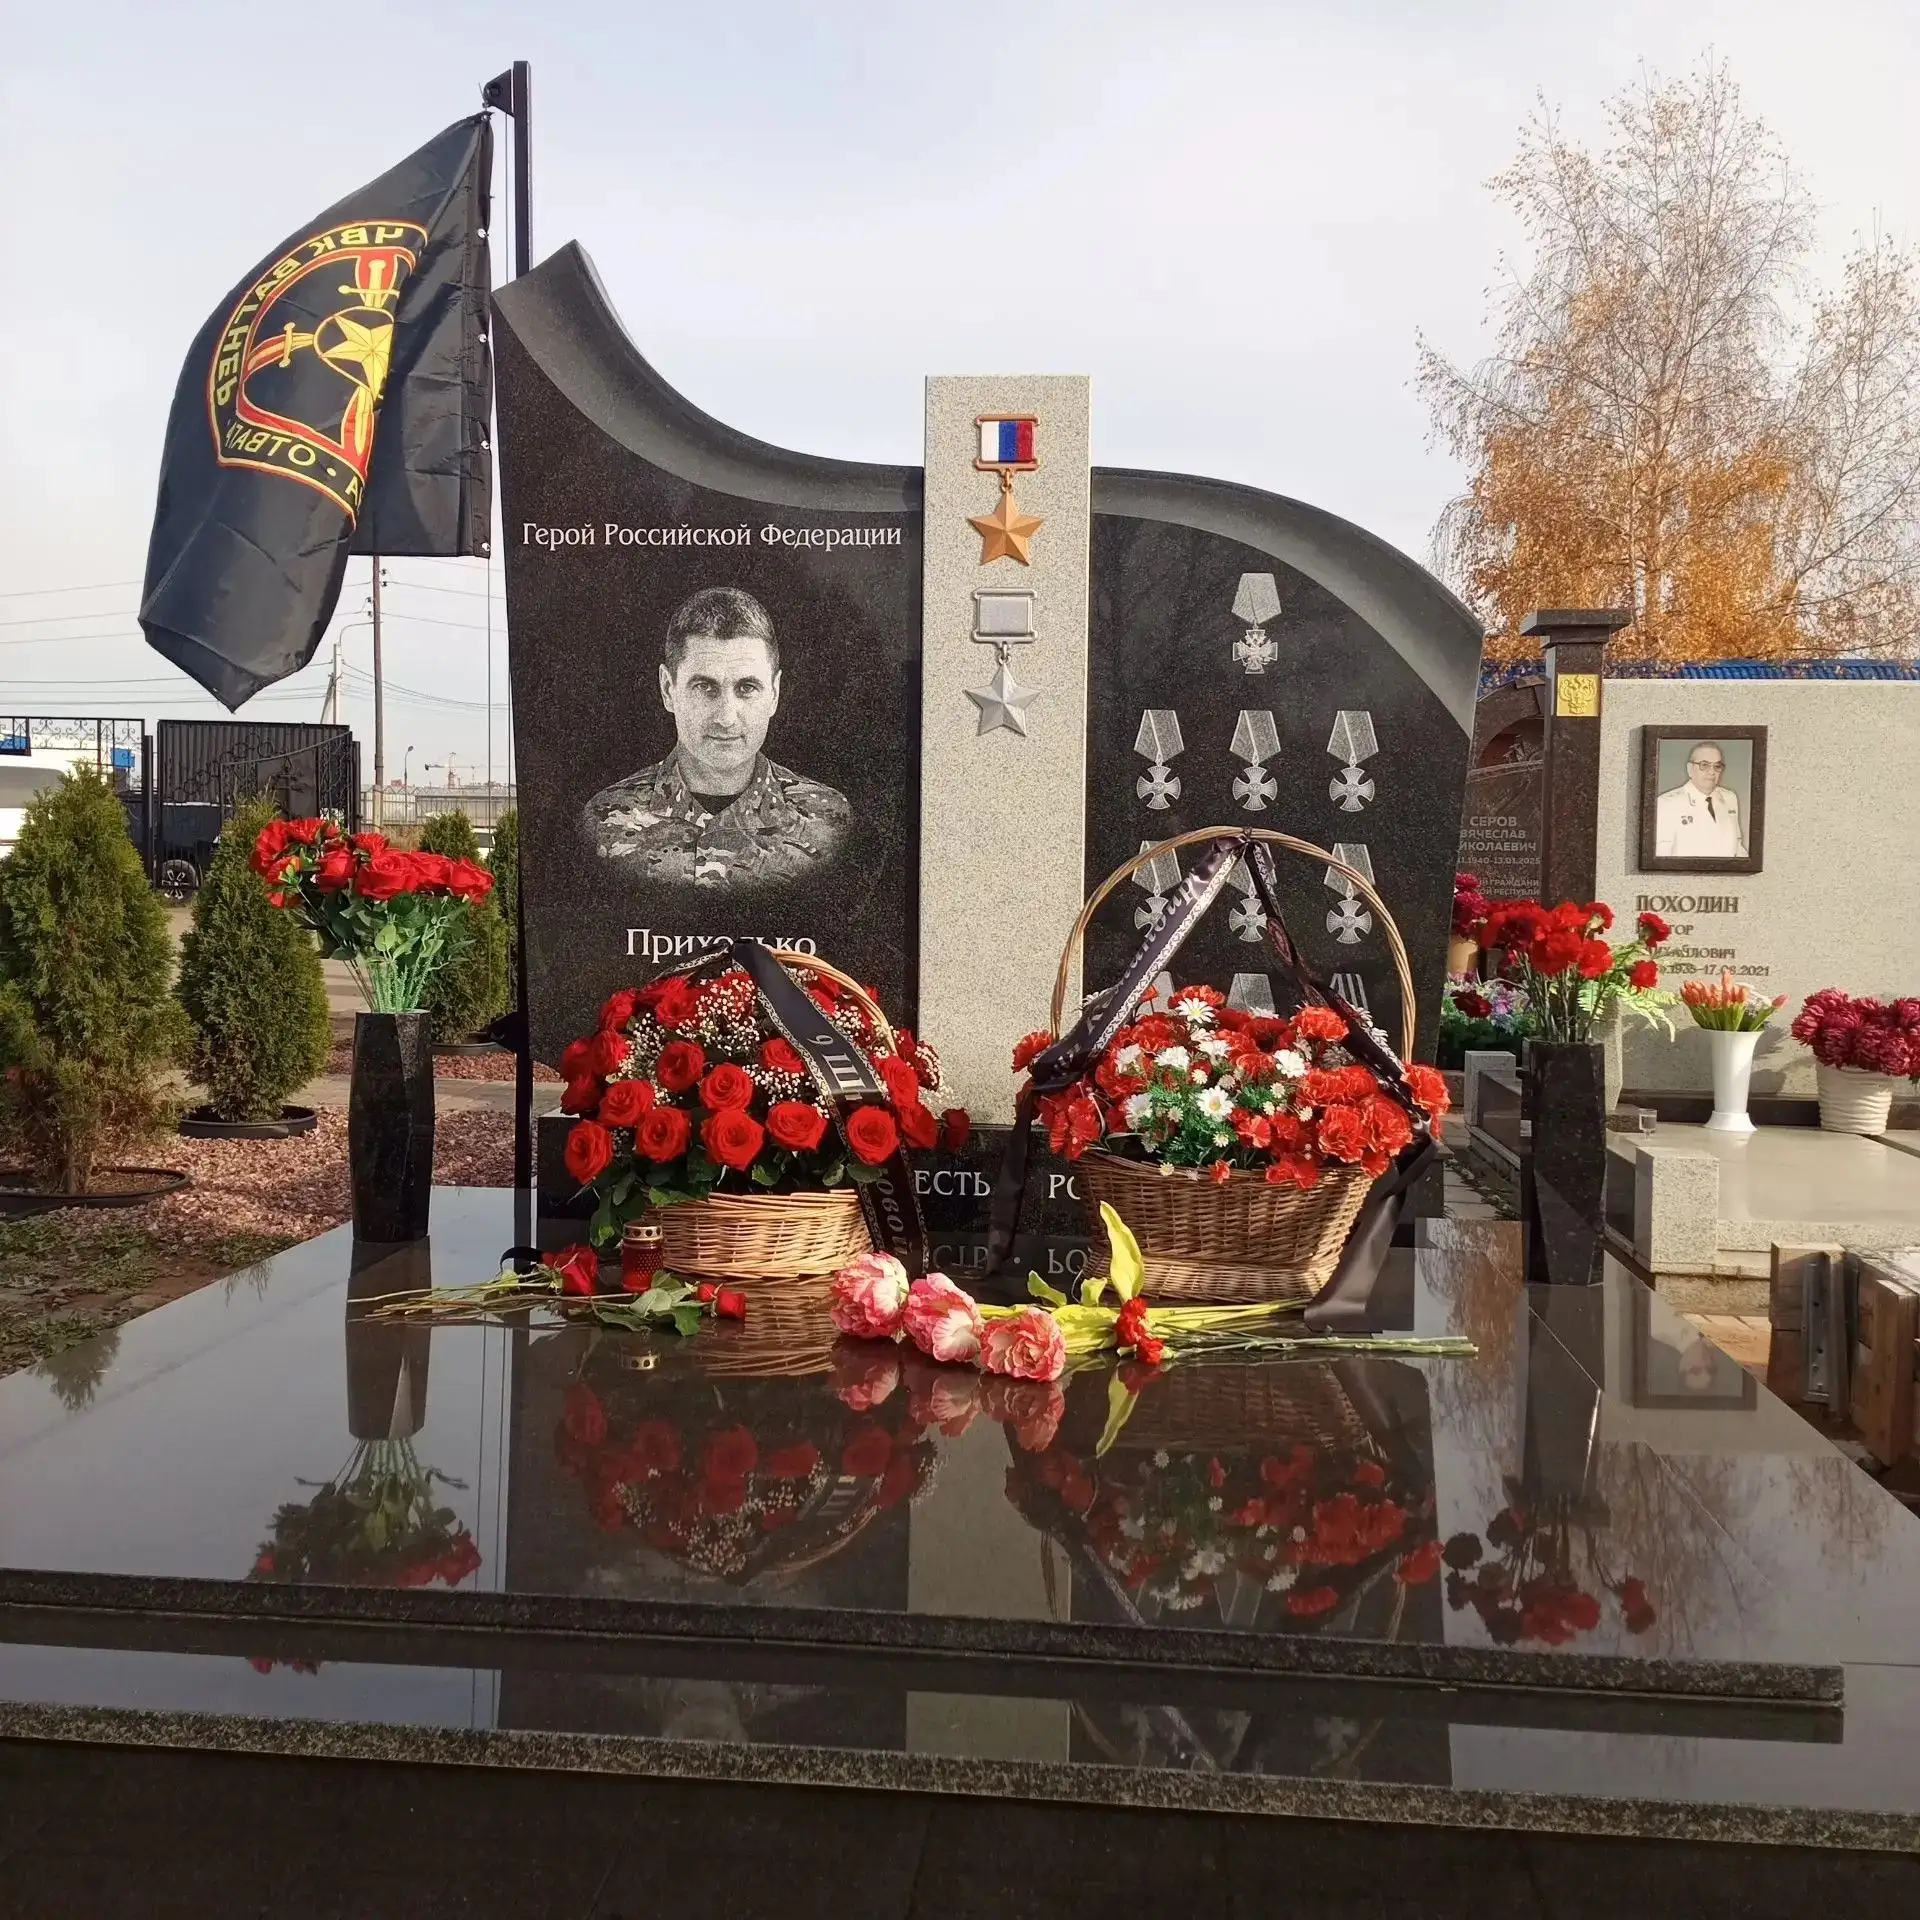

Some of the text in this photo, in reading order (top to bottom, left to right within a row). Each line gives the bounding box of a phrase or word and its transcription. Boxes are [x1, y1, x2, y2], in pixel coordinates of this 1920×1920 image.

[522, 522, 902, 552] Герой Российской Федерации
[1469, 815, 1518, 828] СЕРОВ
[1460, 828, 1526, 840] ВЯЧЕСЛАВ
[1459, 841, 1537, 852] ИКОЛАЕВИЧ
[1490, 879, 1540, 888] ГРАЖДАНИ
[1493, 888, 1541, 897] РЕСПУБЛИ
[1636, 894, 1739, 914] ПОХОДИН
[1650, 943, 1736, 960] ИХАЙЛОВИЧ
[914, 1169, 991, 1197] ЕСТЬ
